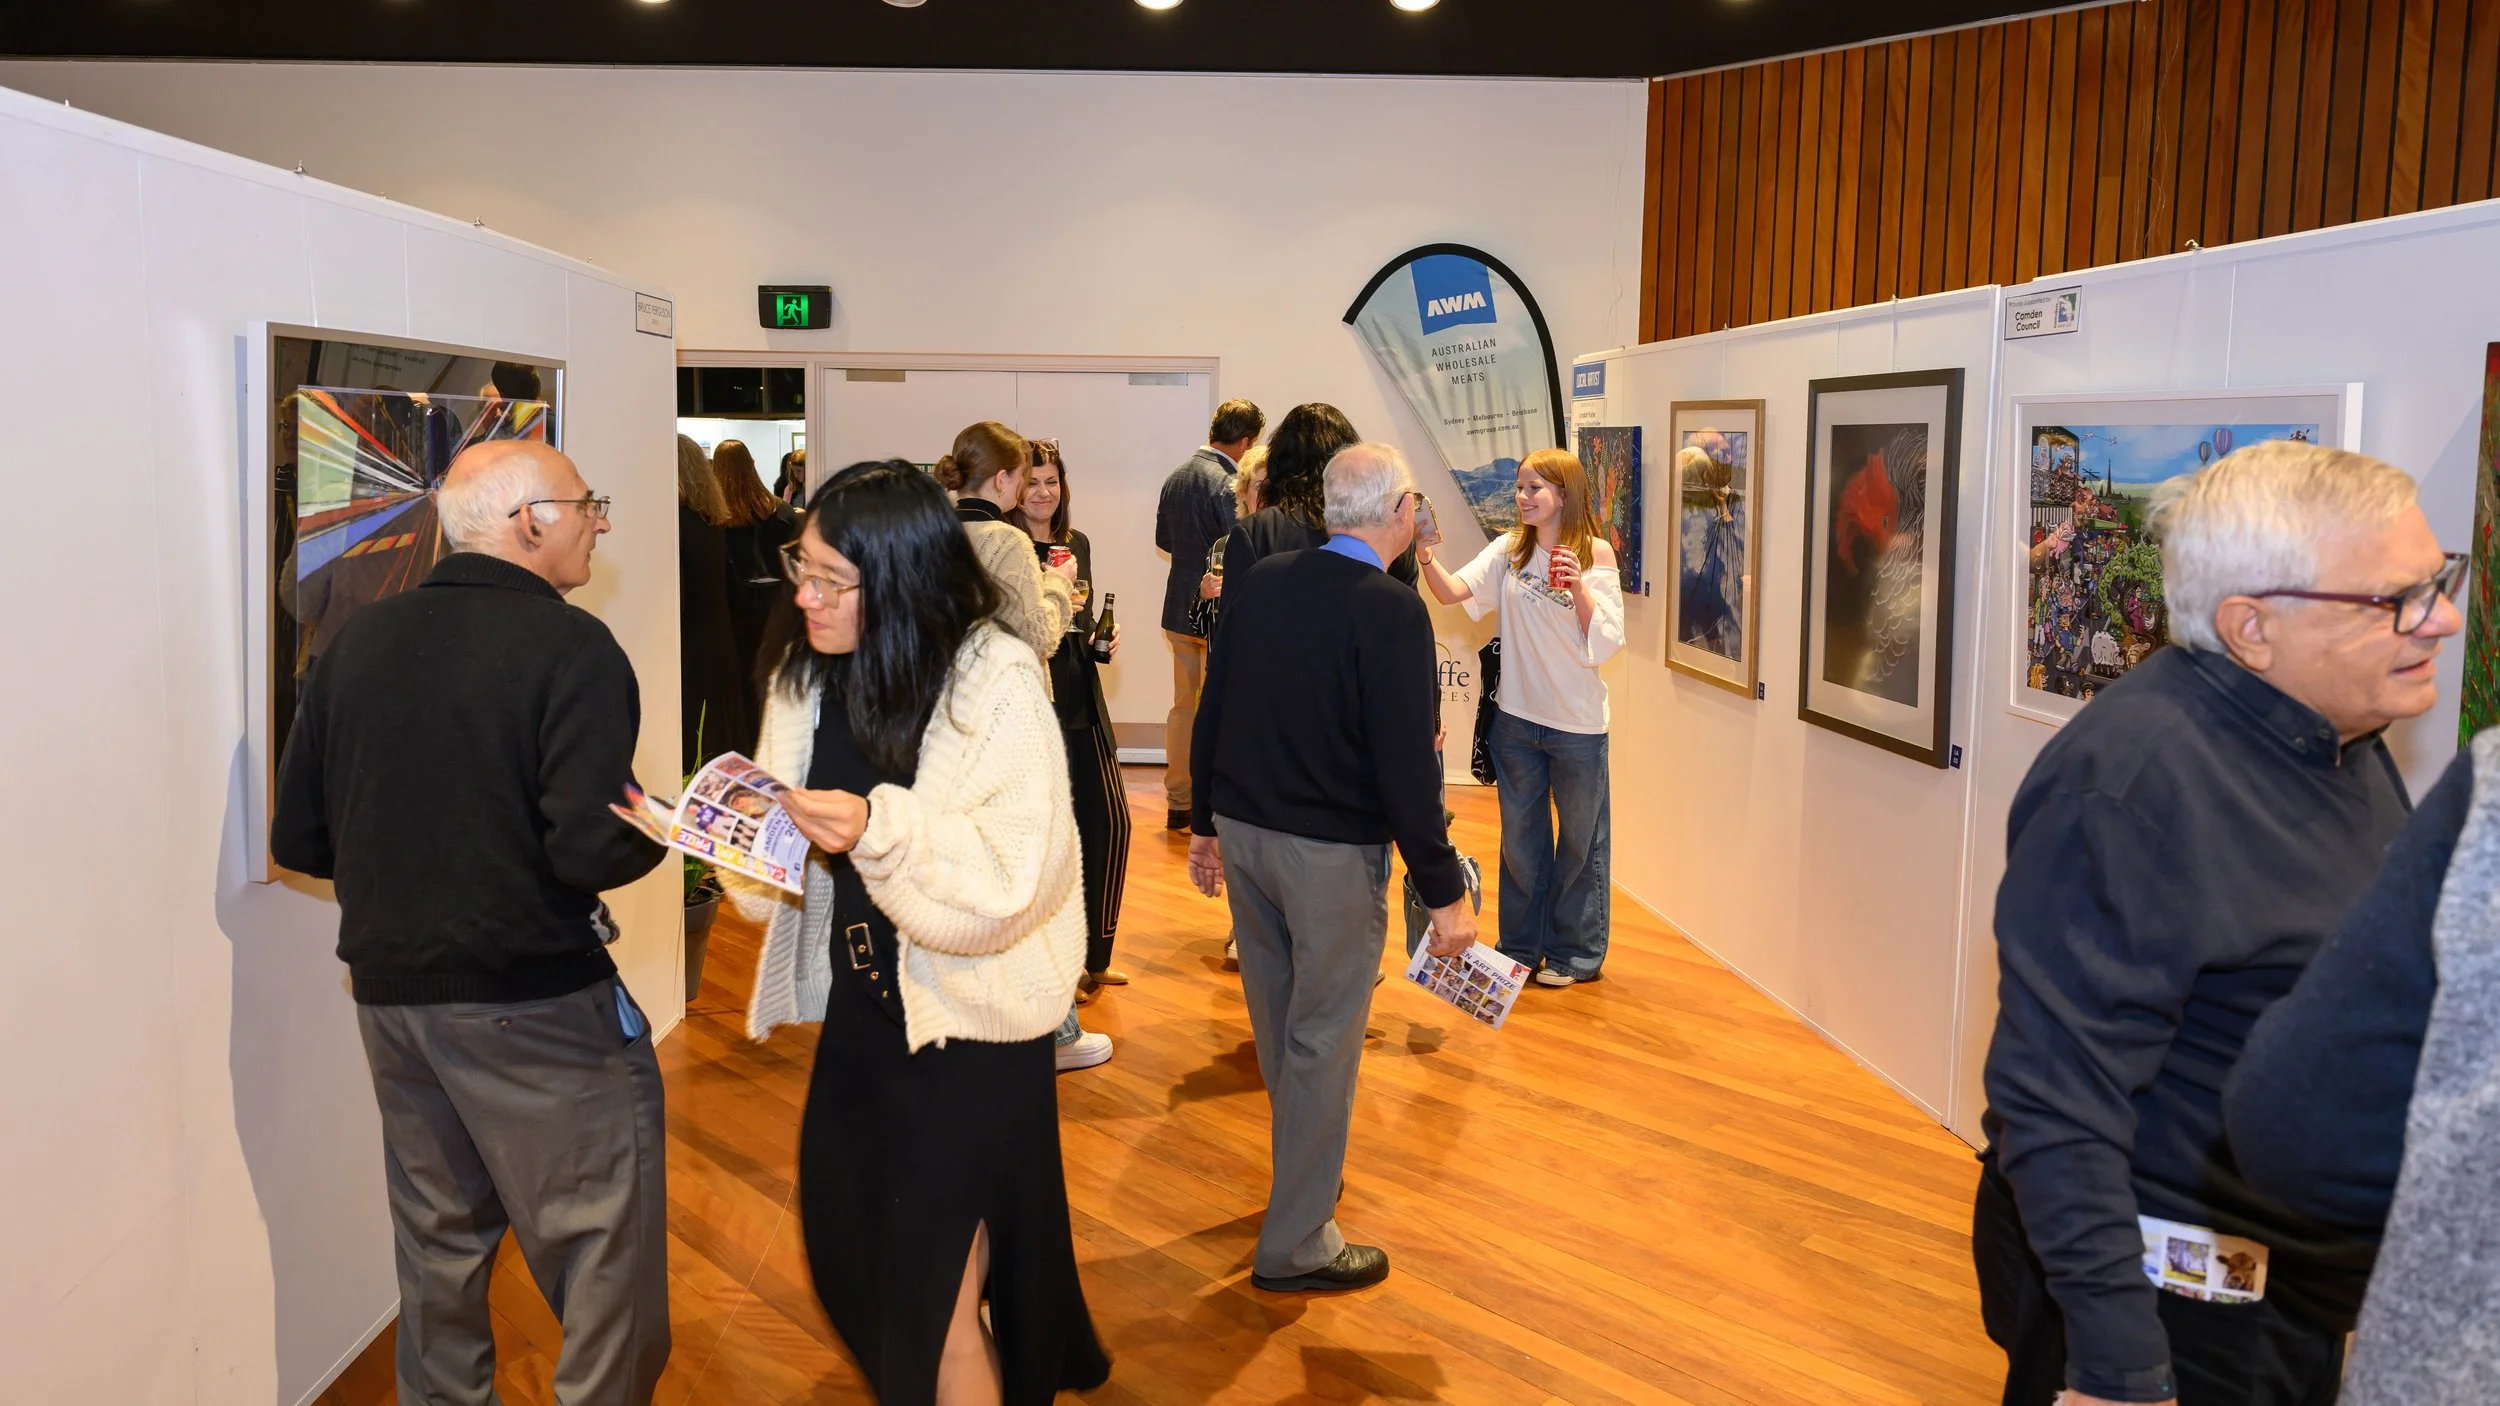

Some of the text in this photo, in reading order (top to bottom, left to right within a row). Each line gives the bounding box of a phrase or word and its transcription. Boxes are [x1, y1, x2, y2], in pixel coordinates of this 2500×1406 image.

[638, 301, 651, 314] BRUCE
[1427, 291, 1486, 317] AWM
[2015, 310, 2042, 321] Camden
[2016, 320, 2041, 331] Council
[1431, 338, 1497, 357] AUSTRALIAN
[1435, 354, 1497, 372] WHOLESALE
[1451, 372, 1485, 385] MEATS
[1576, 371, 1600, 388] LOCAL ARTIST
[1443, 407, 1538, 426] Sydney Melbourne Brisbane
[1466, 423, 1520, 436] awmgroup.com.au
[1437, 660, 1470, 687] ffe
[785, 823, 797, 838] 20
[677, 830, 713, 851] PRIZE
[1473, 959, 1490, 972] ART
[1491, 972, 1516, 991] PRIZE
